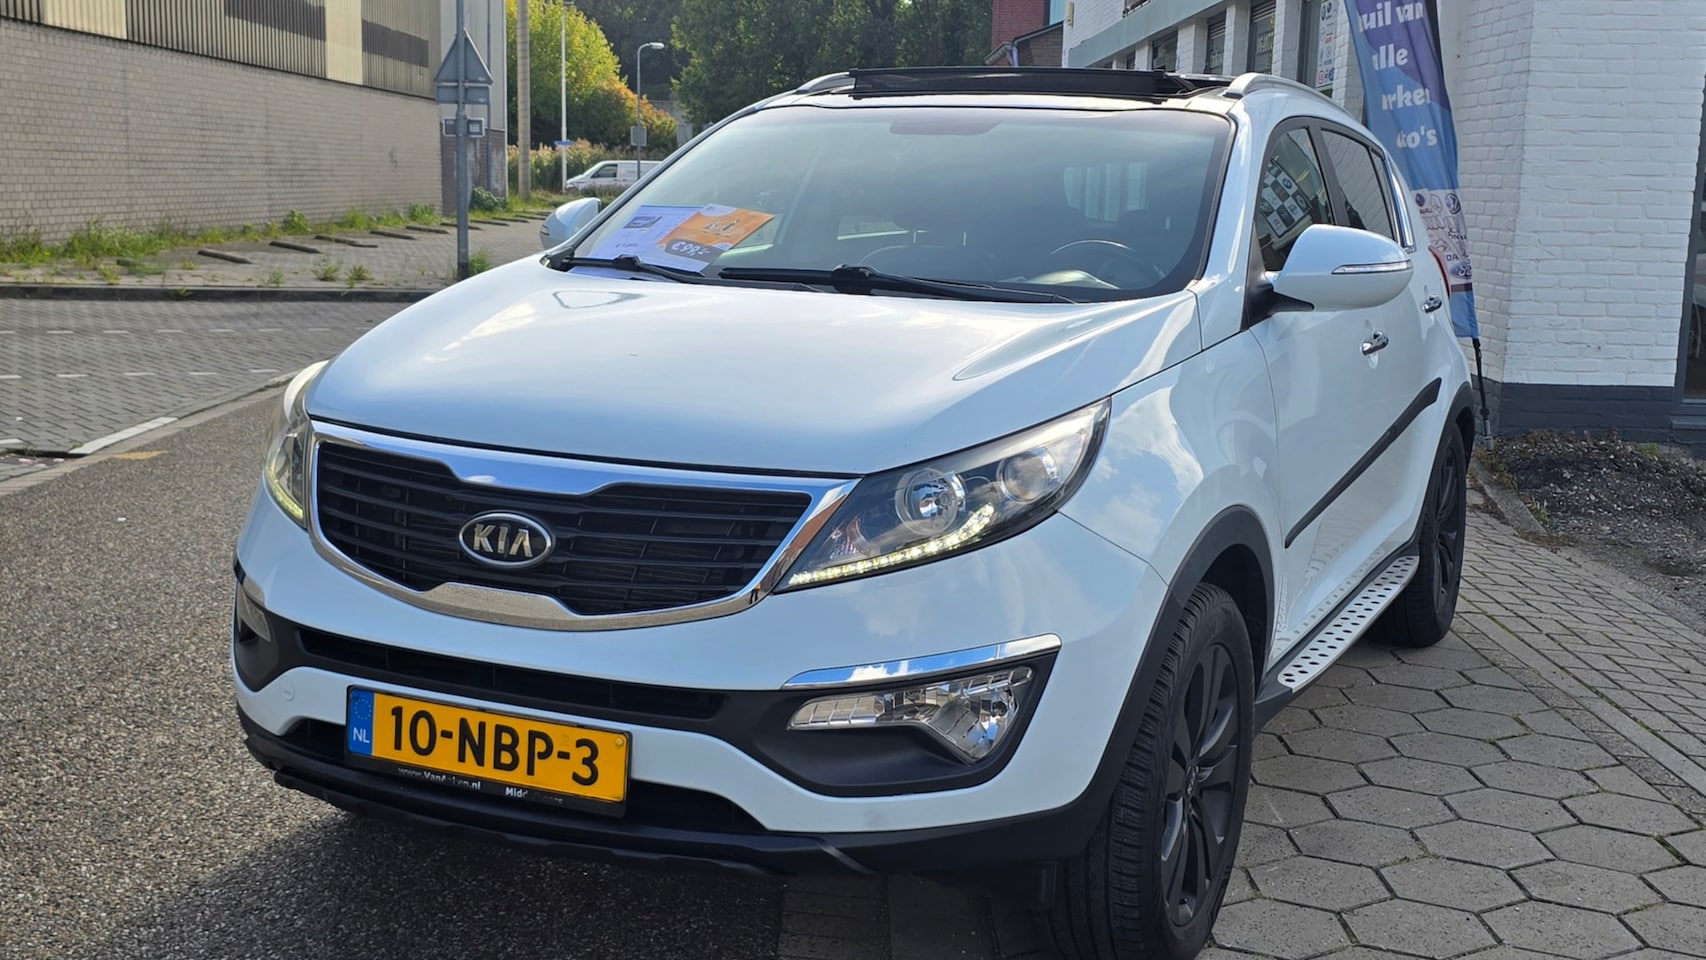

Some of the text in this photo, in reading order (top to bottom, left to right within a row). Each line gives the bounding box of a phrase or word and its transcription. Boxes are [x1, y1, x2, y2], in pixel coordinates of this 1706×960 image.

[473, 523, 533, 557] KIA
[353, 727, 370, 743] NL
[391, 706, 600, 786] 10-NBP-3
